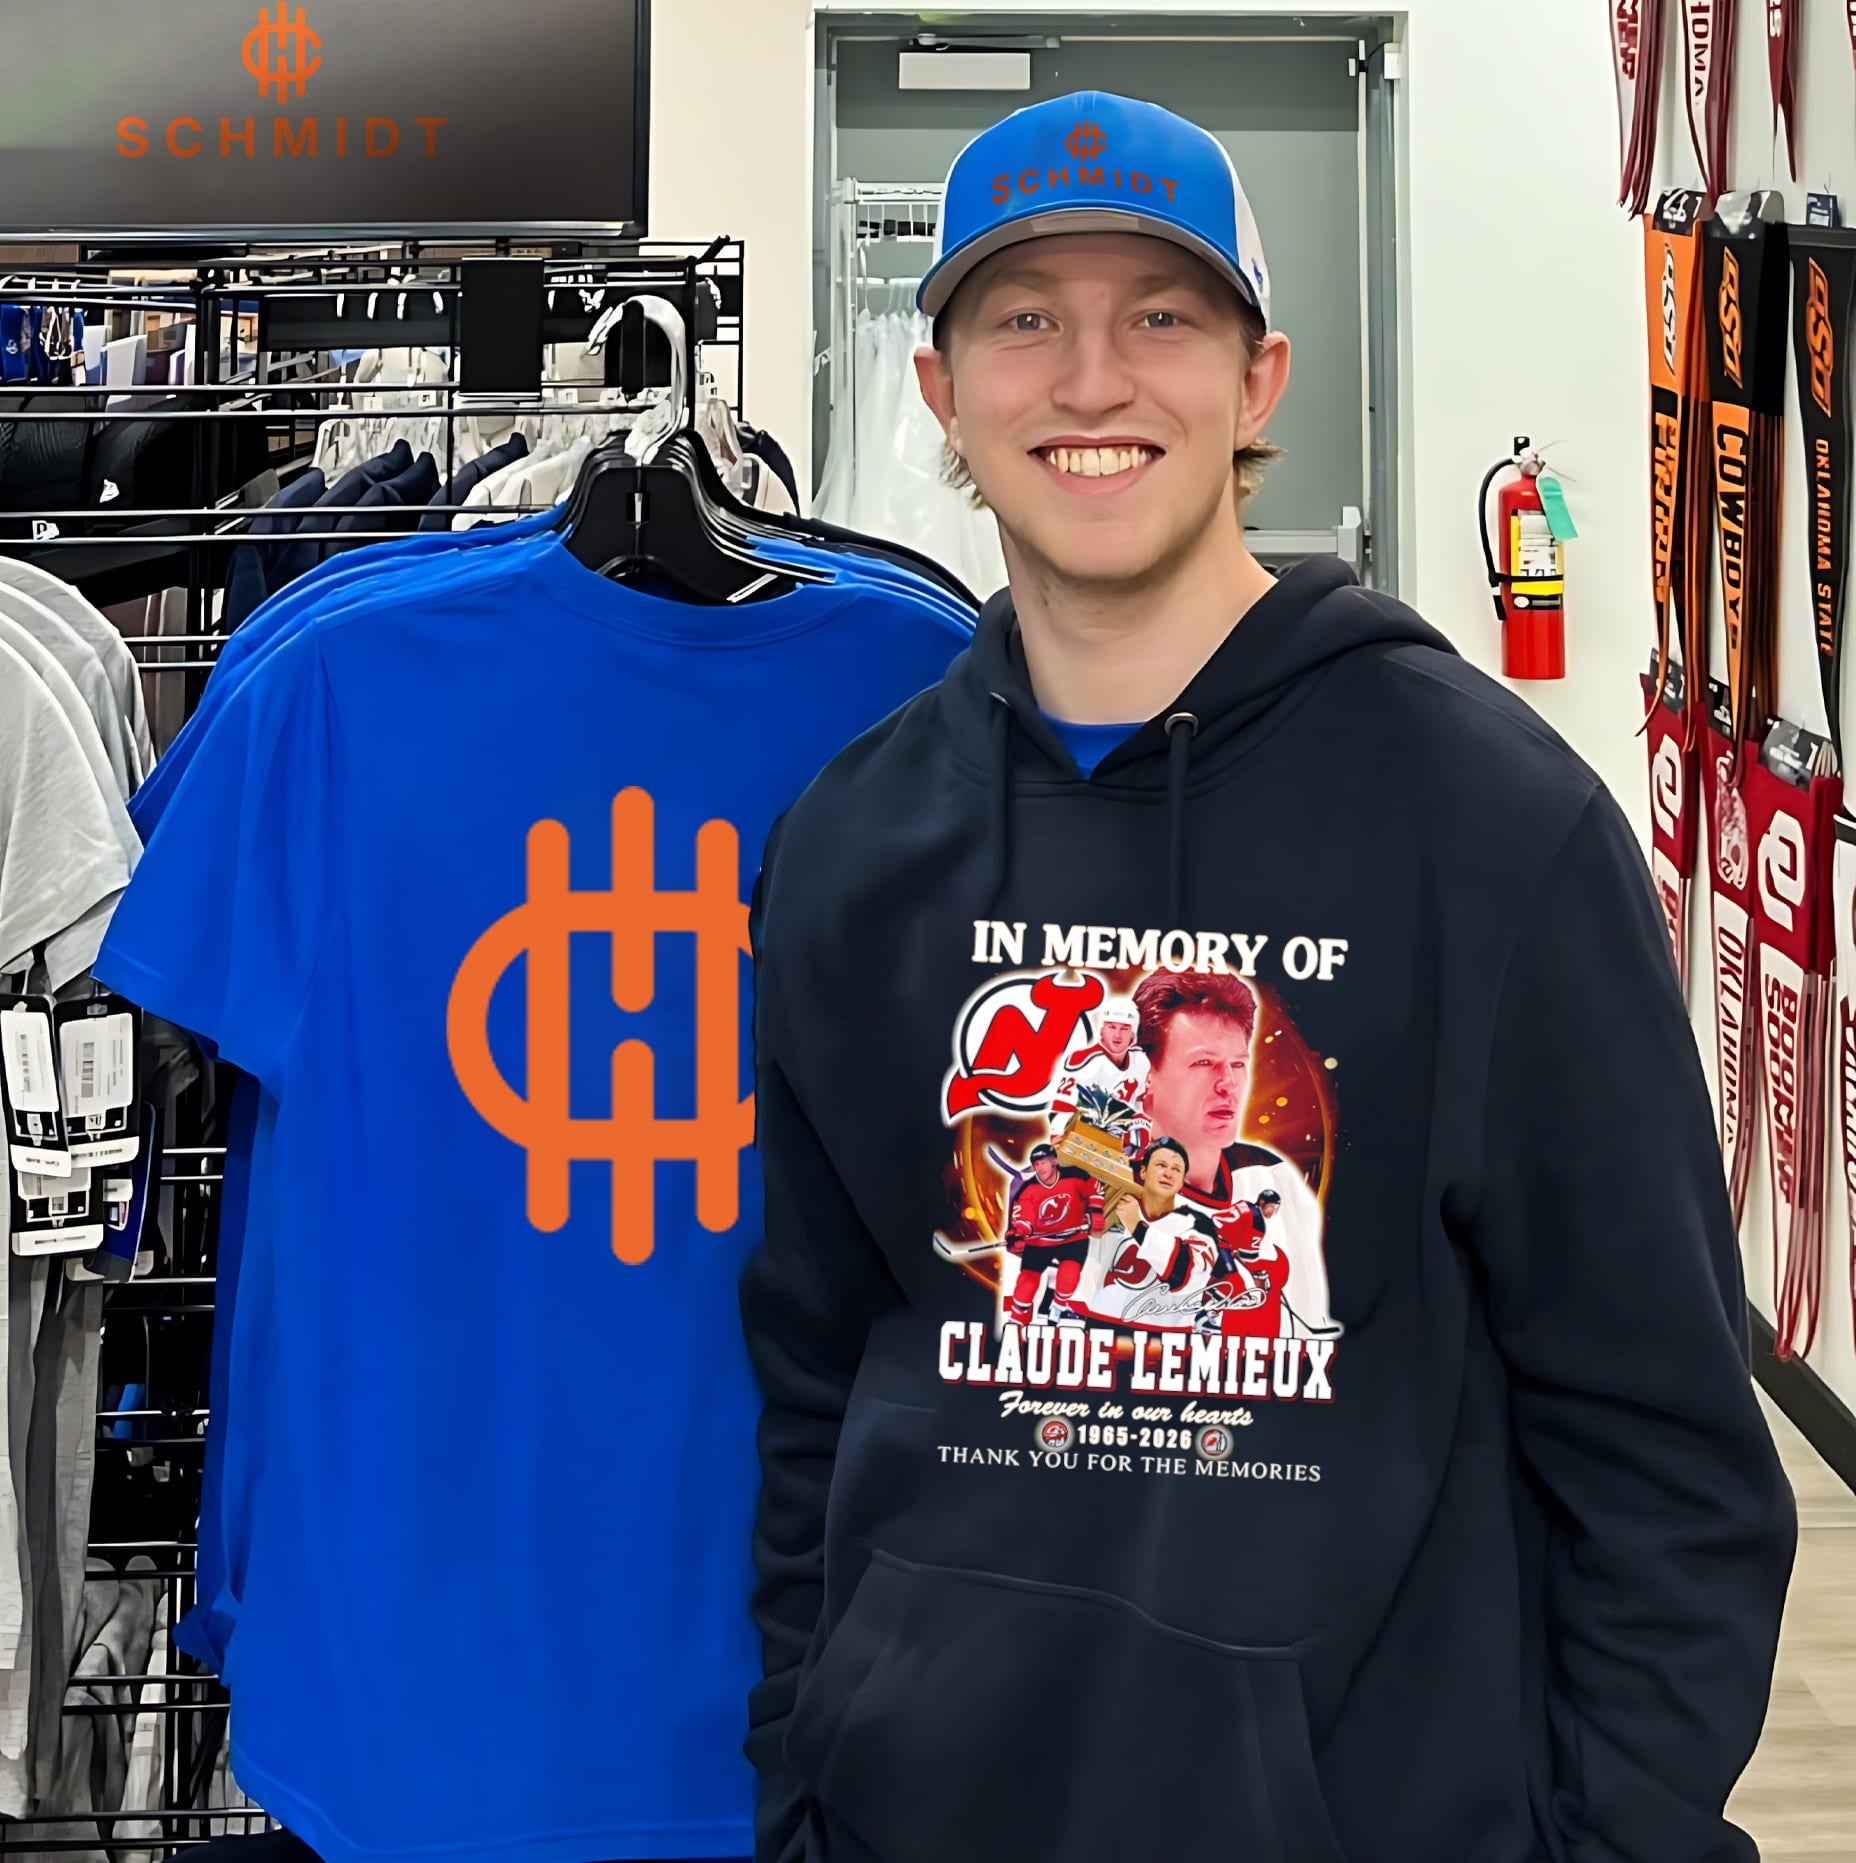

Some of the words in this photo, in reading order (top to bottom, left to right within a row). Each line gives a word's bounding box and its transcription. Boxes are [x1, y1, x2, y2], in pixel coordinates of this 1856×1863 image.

[115, 116, 448, 159] SCHMIDT
[991, 167, 1179, 204] SCHMIDT
[971, 920, 1027, 965] IN
[1041, 923, 1268, 977] MEMORY
[1282, 936, 1349, 981] OF
[938, 1320, 1117, 1391] CLAUDE
[1130, 1330, 1337, 1402] LEMIEUX
[998, 1390, 1090, 1419] Forever
[1098, 1400, 1124, 1419] in
[1131, 1405, 1173, 1424] our
[1180, 1400, 1254, 1427] hearts
[1077, 1424, 1193, 1450] 1965-2026
[937, 1446, 1022, 1467] THANK
[1028, 1451, 1080, 1470] YOU
[1087, 1454, 1133, 1473] FOR
[1140, 1456, 1187, 1475] THE
[1195, 1459, 1321, 1483] MEMORIES
